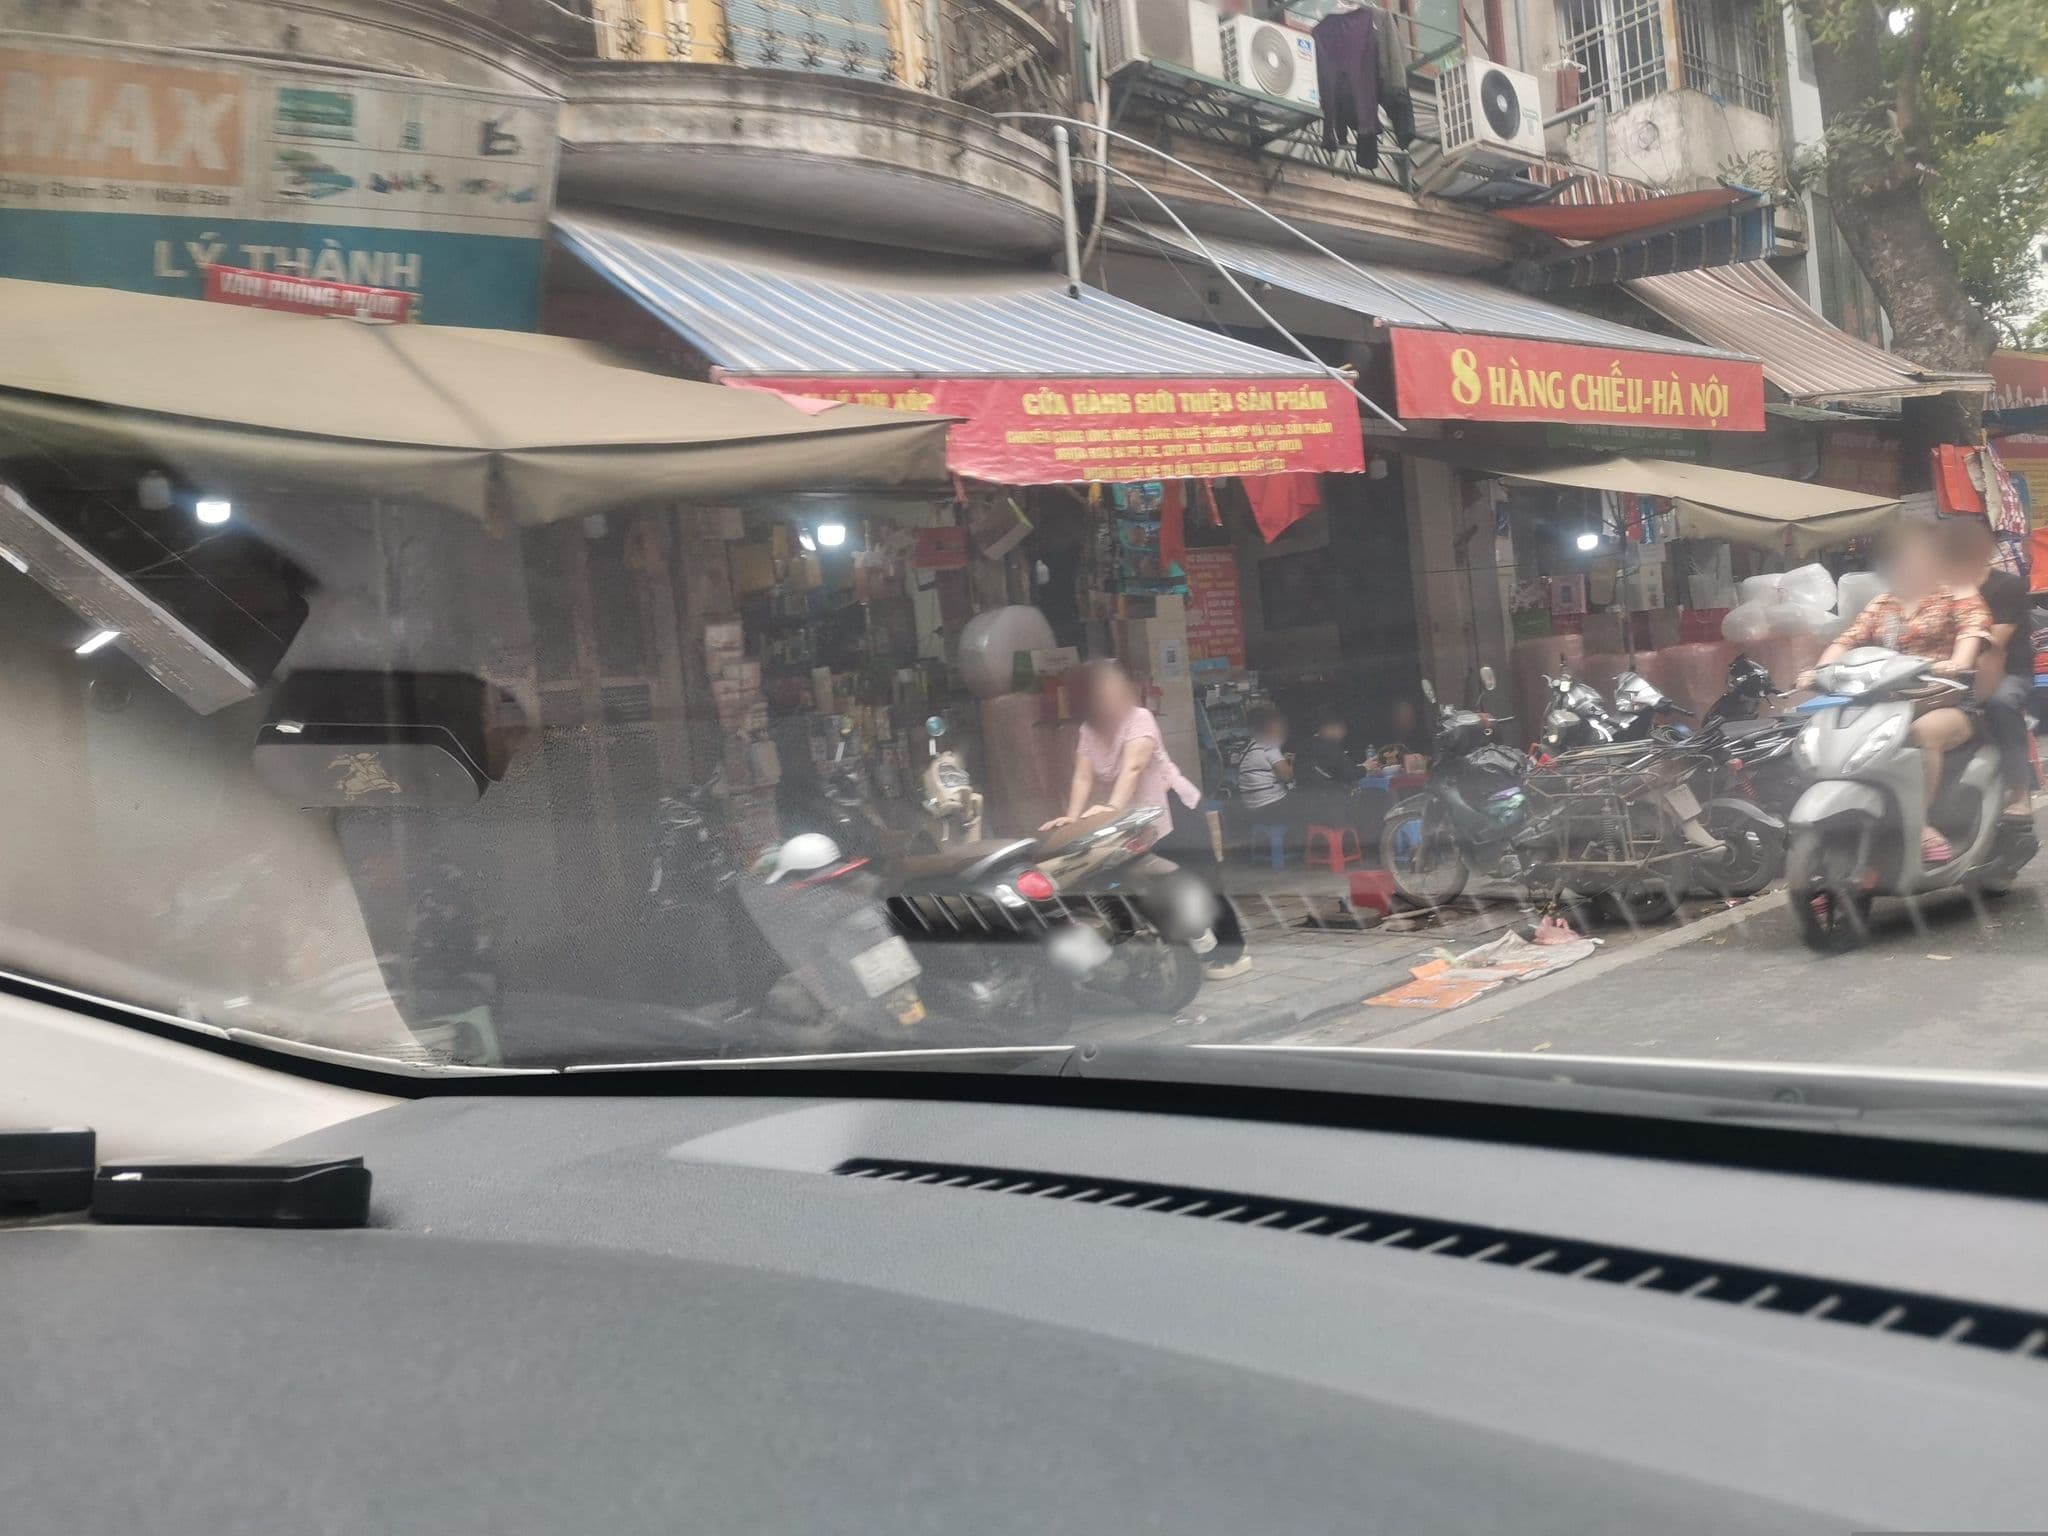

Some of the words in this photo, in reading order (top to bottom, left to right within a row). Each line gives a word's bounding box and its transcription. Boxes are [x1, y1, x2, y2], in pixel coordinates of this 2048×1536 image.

[239, 238, 423, 289] THÀNH
[1022, 386, 1070, 416] CỬA
[1072, 389, 1132, 415] HÀNG
[1177, 388, 1233, 417] THIỆU
[1236, 386, 1274, 411] SẢN
[1275, 384, 1328, 411] PHẨM
[1450, 348, 1482, 405] 8
[1487, 355, 1566, 410] HÀNG
[1690, 373, 1730, 428] NỘI
